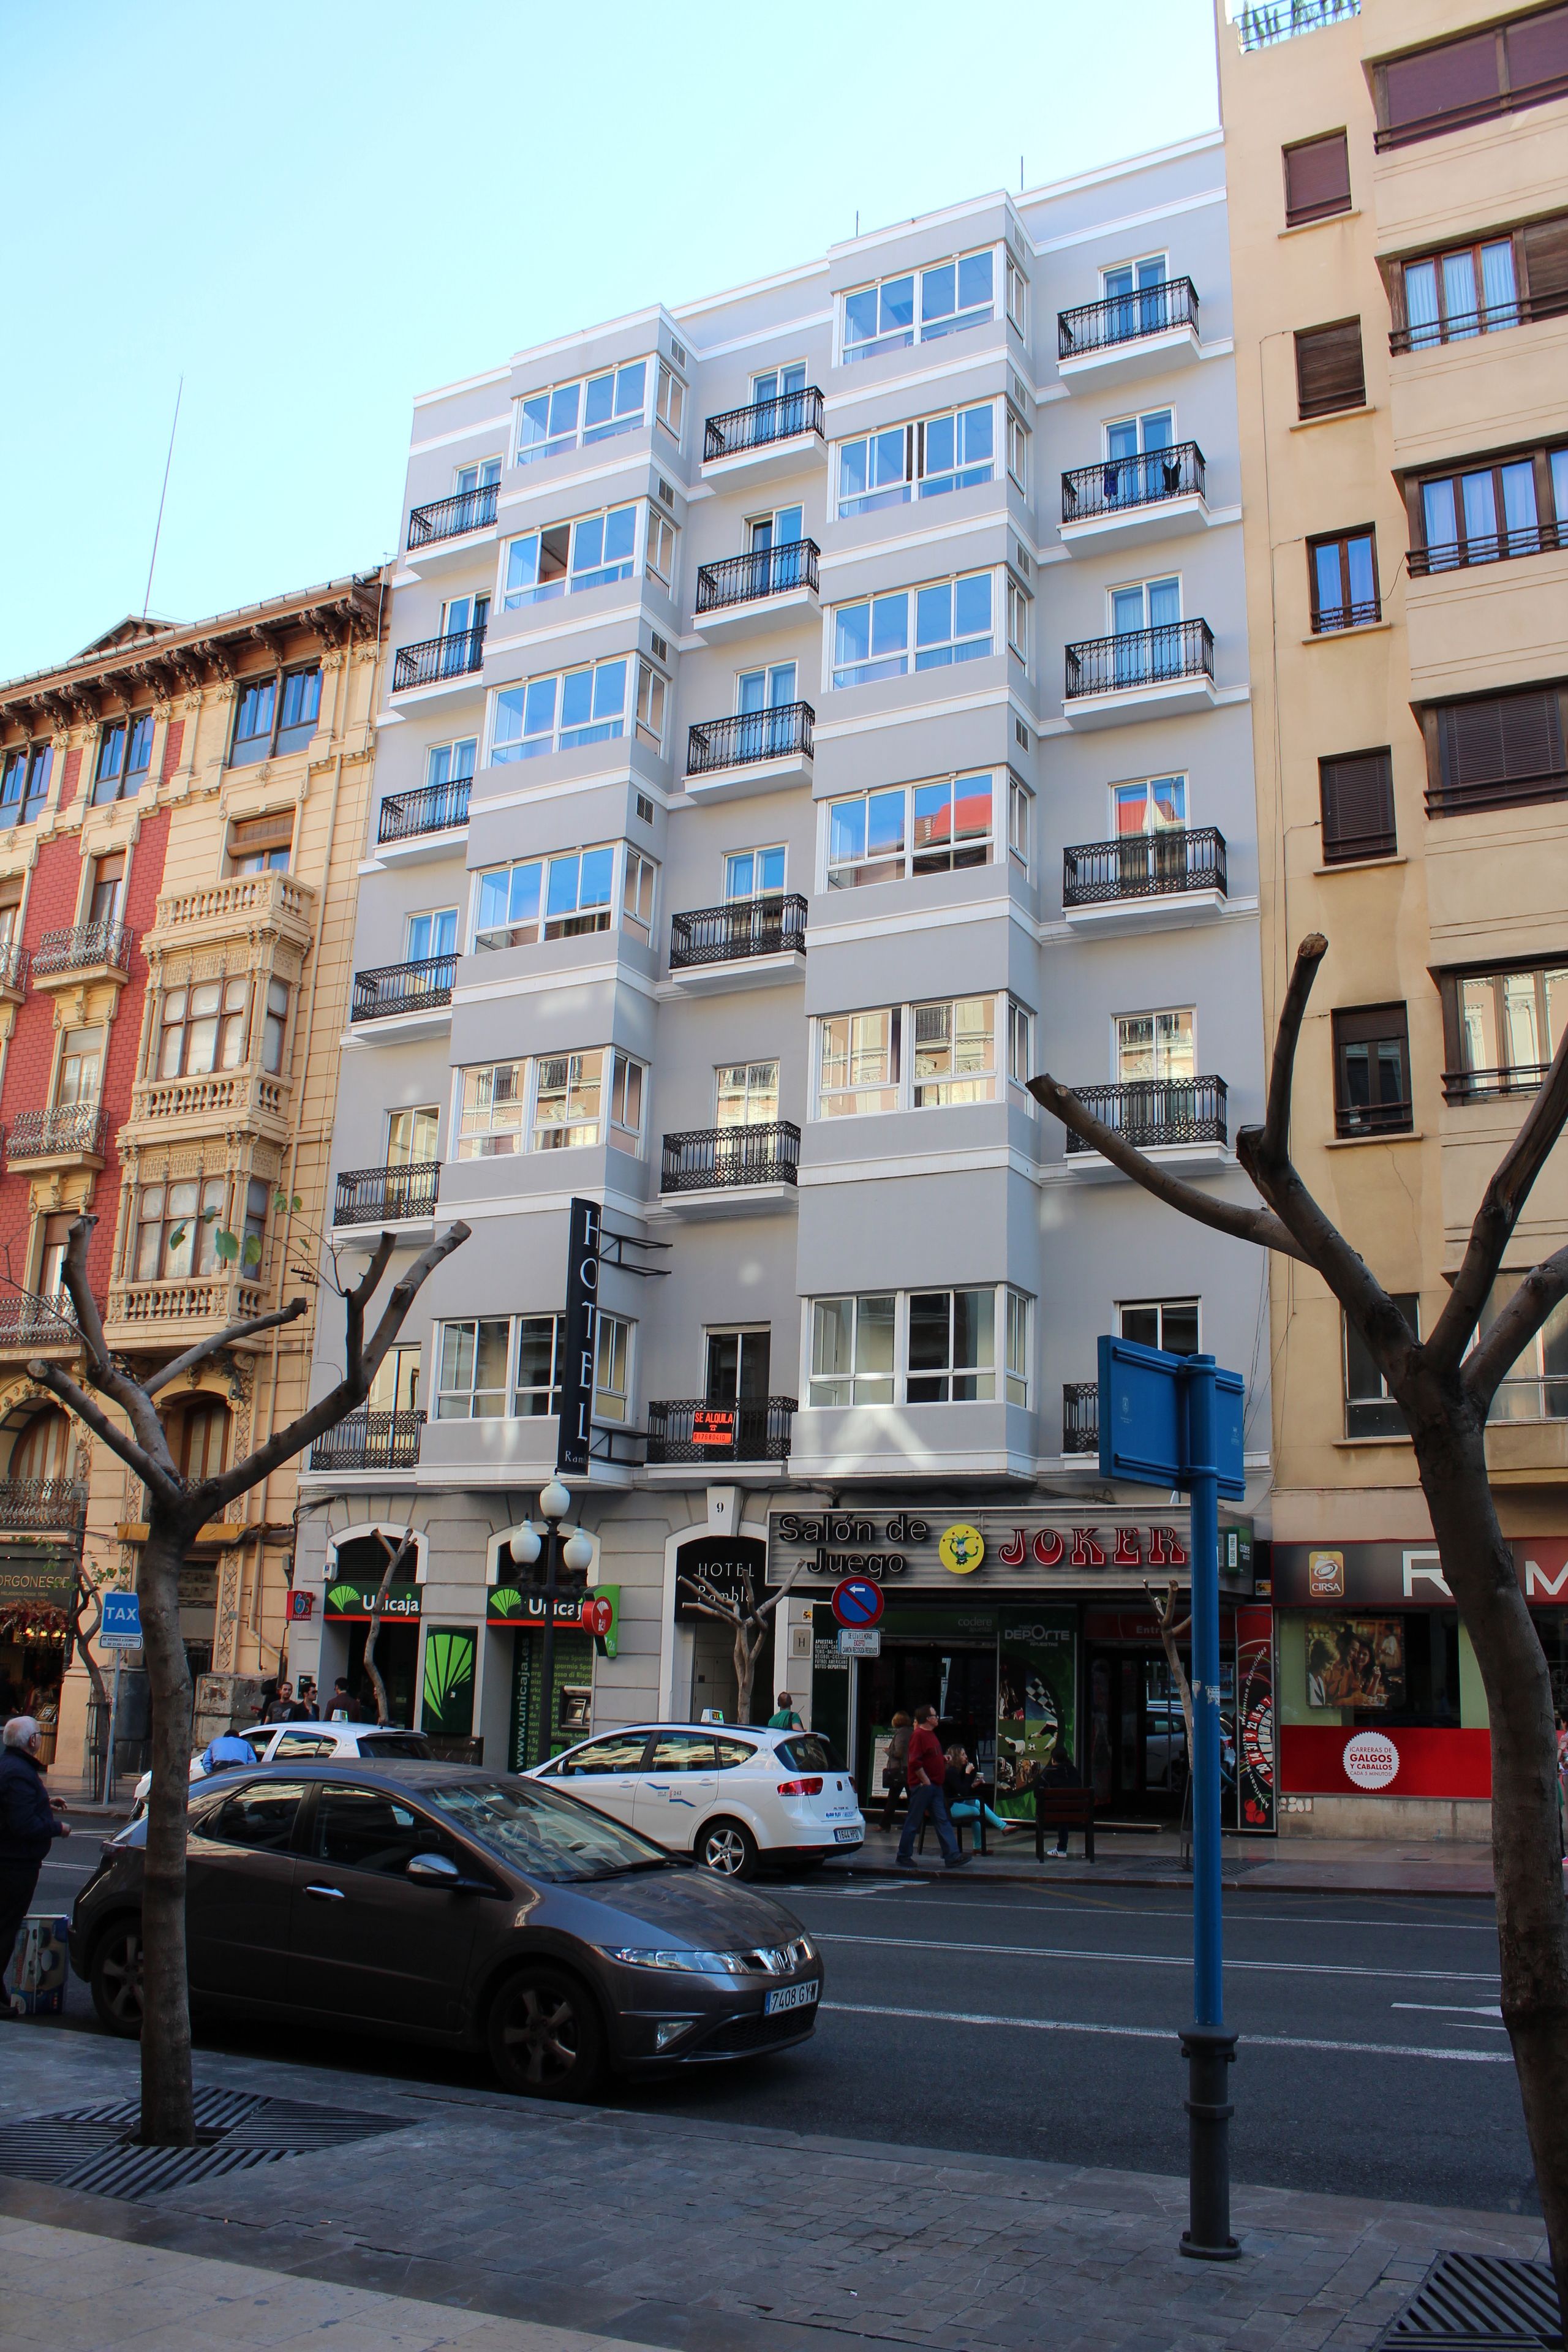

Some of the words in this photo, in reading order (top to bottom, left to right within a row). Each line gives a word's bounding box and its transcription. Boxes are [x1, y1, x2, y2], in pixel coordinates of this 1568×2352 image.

[577, 1210, 600, 1442] HOTEL
[695, 1412, 704, 1423] SE
[705, 1413, 733, 1423] ALQUILA
[716, 1502, 724, 1513] 9
[778, 1513, 875, 1542] Salón
[886, 1513, 931, 1542] de
[998, 1526, 1188, 1566] JOKER
[698, 1562, 755, 1577] HOTEL
[807, 1547, 907, 1581] Juego
[1311, 1583, 1341, 1592] CIRSA
[105, 1607, 137, 1621] TAX
[363, 1593, 420, 1616] Uicaja
[528, 1597, 582, 1621] Uicaj
[957, 1617, 992, 1627] codere
[798, 1637, 805, 1647] H
[1245, 1646, 1267, 1686] Especiales
[516, 1637, 530, 1768] www.unicaja.es
[1350, 1754, 1392, 1763] GALGOS
[1249, 1773, 1270, 1809] American
[838, 1830, 850, 1839] 1644
[772, 1988, 796, 2010] 7408
[798, 1983, 816, 2003] GYW
